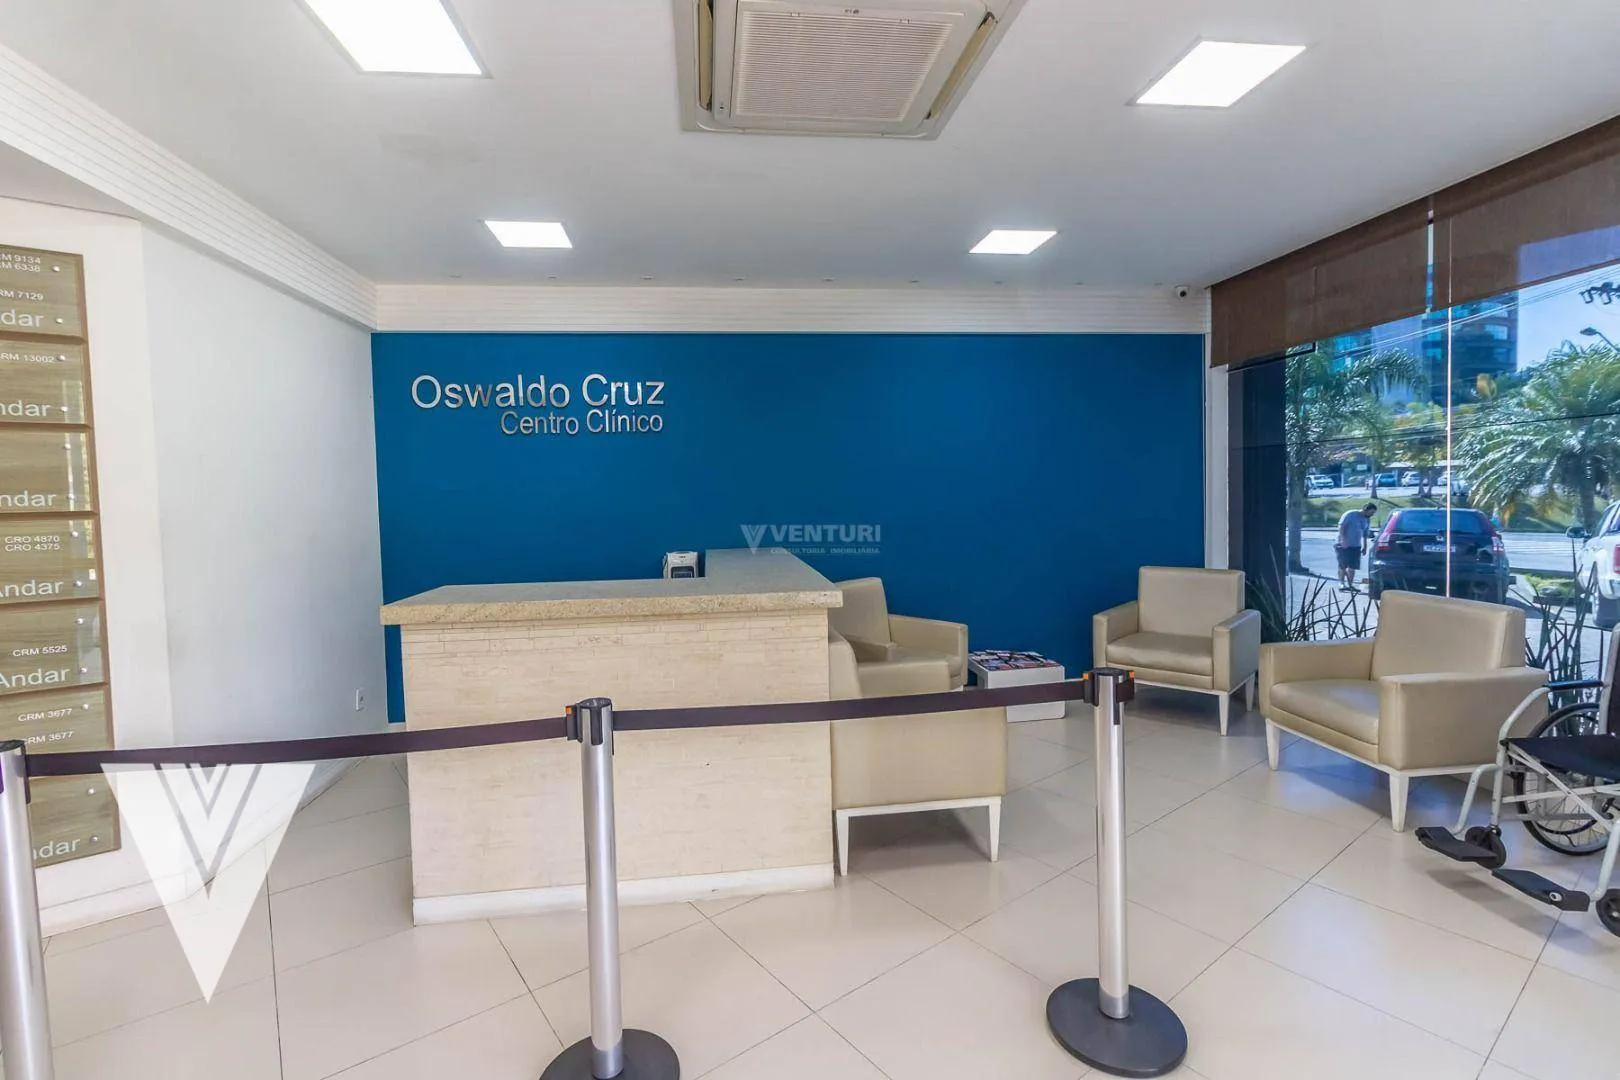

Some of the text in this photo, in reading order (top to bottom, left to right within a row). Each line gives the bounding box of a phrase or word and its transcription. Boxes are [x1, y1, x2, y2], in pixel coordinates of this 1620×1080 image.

[0, 288, 44, 301] RM 7129
[0, 309, 44, 328] dar
[0, 352, 19, 361] RM
[411, 373, 665, 409] Oswaldo Cruz
[0, 400, 51, 417] ndar
[501, 409, 664, 435] Centro Clínico
[0, 490, 57, 507] ndar
[5, 536, 31, 544] CRO
[5, 544, 31, 552] CRO
[0, 580, 64, 597] ndar
[12, 644, 68, 657] CRM 5525
[18, 712, 45, 722] CRM
